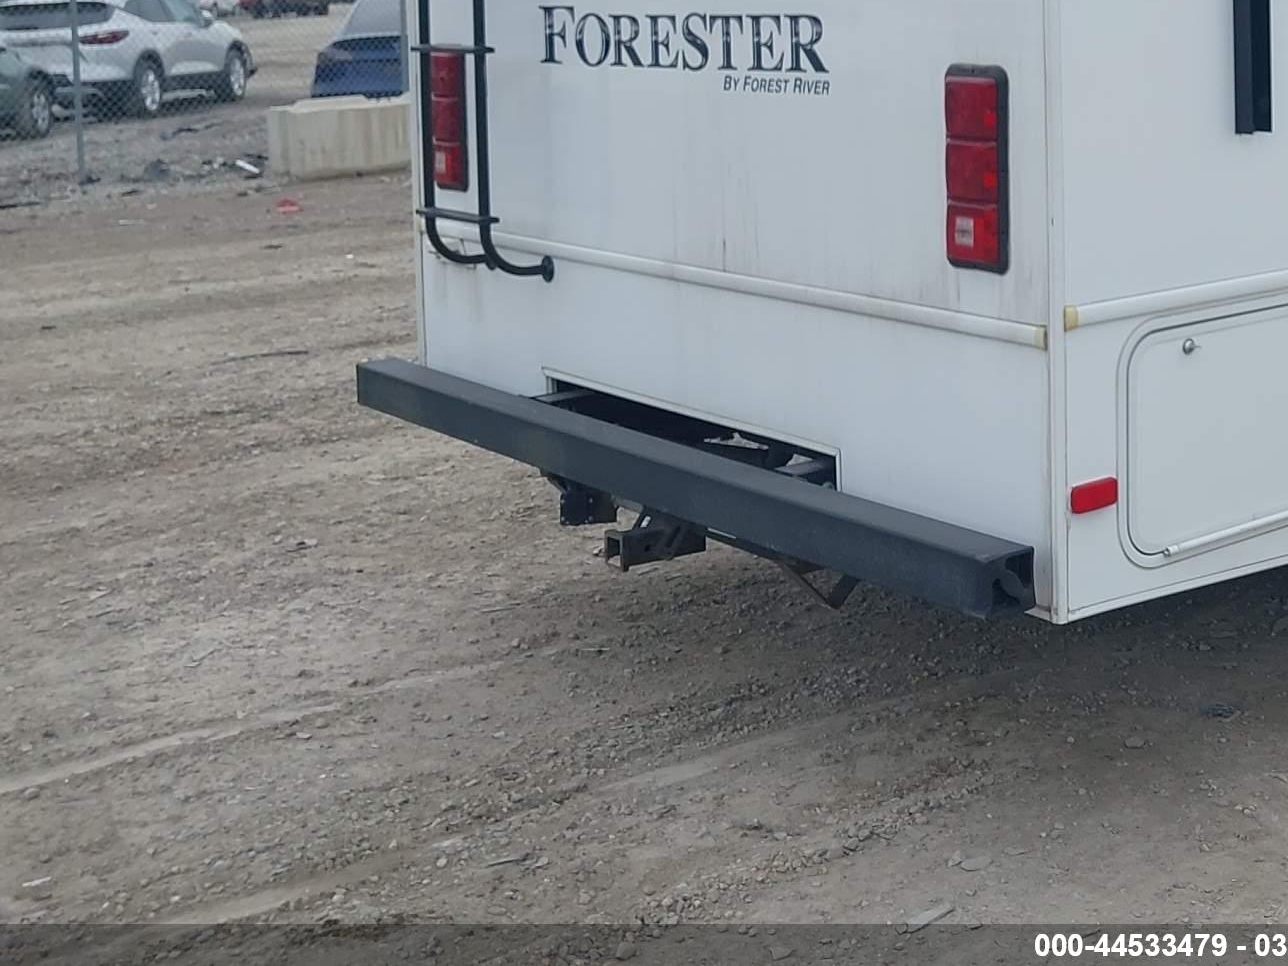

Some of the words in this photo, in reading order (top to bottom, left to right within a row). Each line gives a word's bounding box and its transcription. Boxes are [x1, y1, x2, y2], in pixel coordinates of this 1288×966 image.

[538, 5, 830, 74] FORESTER
[723, 75, 740, 91] BY
[743, 75, 790, 94] FOREST
[793, 77, 831, 96] RIVER
